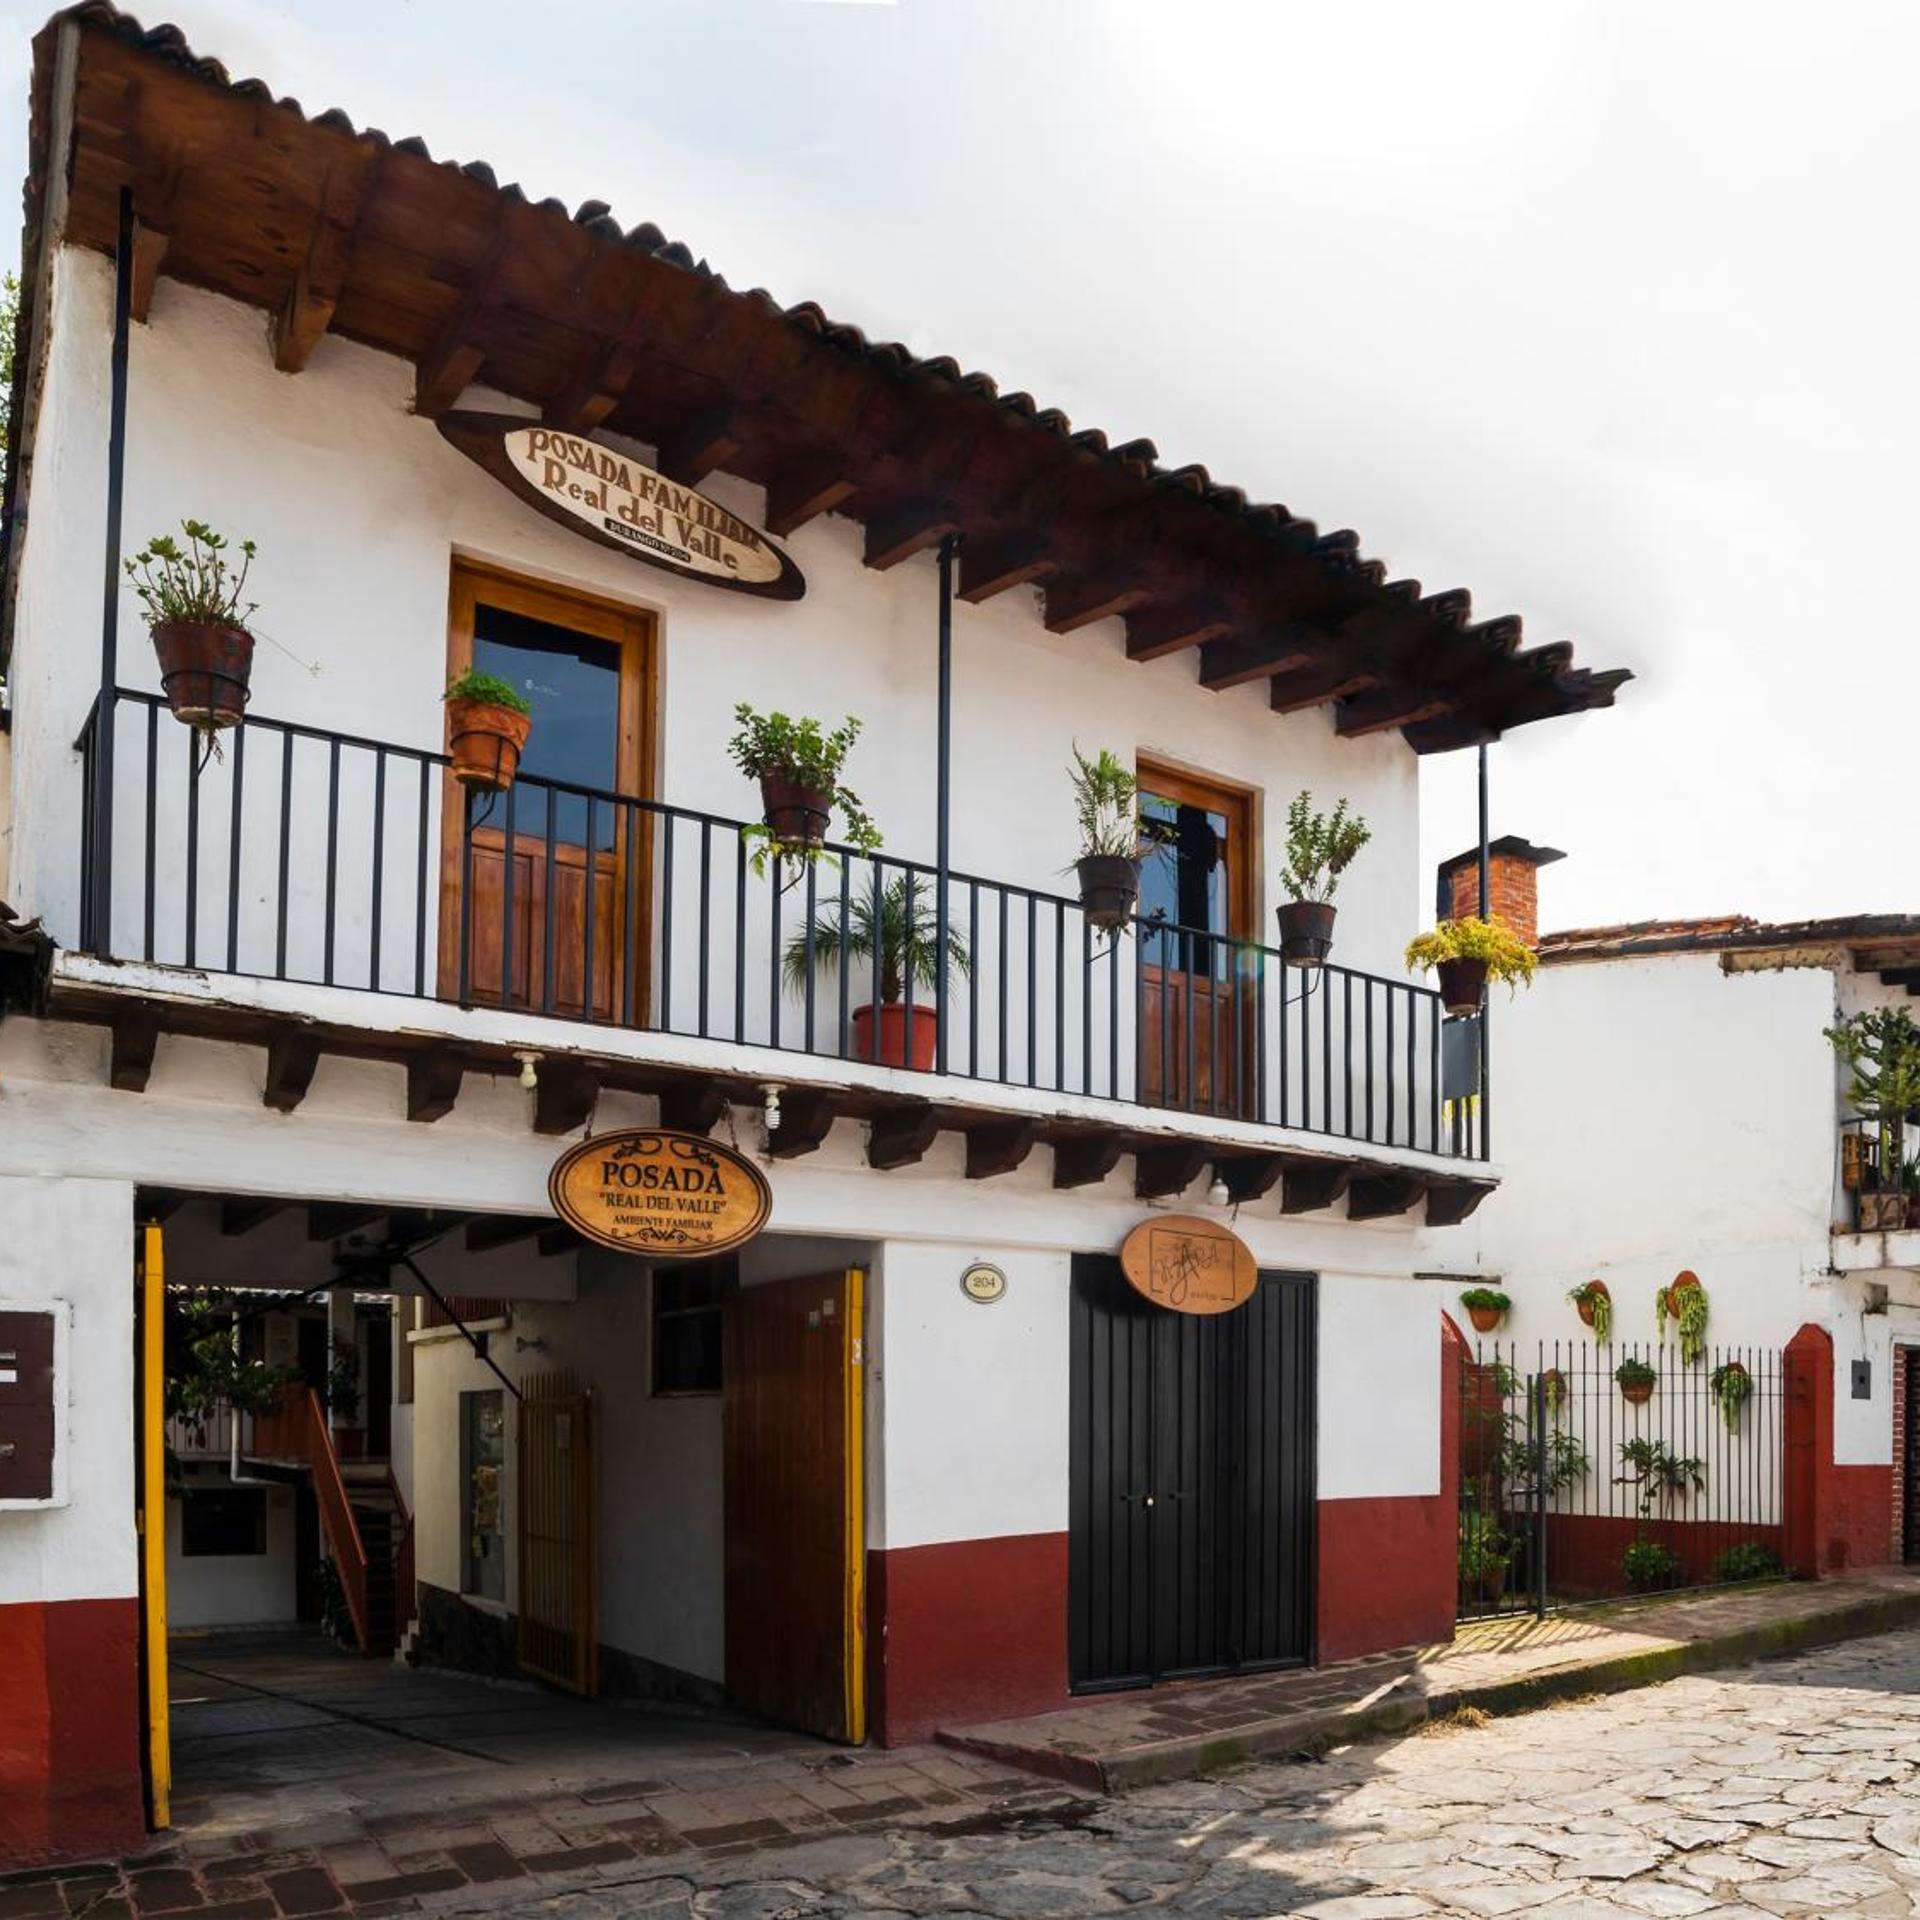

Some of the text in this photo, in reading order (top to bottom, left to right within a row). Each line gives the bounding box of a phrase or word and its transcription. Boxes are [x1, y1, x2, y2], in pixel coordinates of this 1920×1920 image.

[527, 430, 760, 553] POSADA FAMILIAR
[542, 456, 739, 570] Real del Valle
[602, 1161, 726, 1194] POSADA
[647, 1195, 673, 1210] DEL
[613, 1215, 713, 1231] AMBIENTE FAMILIAR
[972, 1276, 995, 1288] 204
